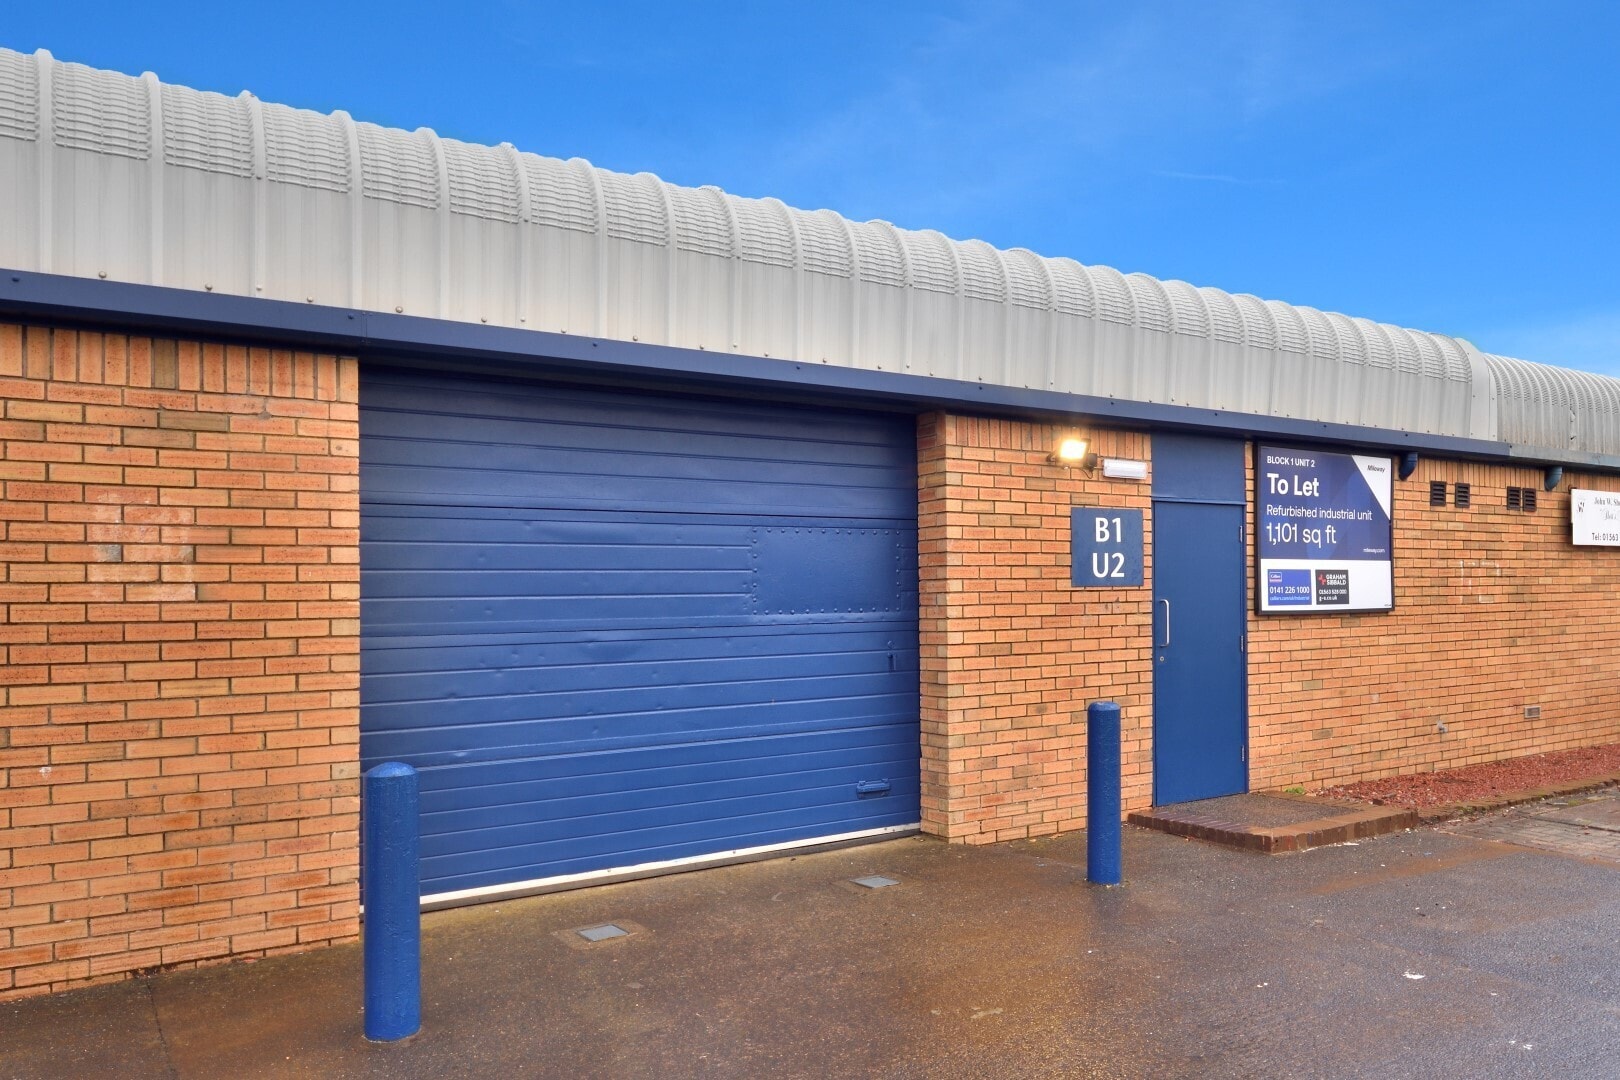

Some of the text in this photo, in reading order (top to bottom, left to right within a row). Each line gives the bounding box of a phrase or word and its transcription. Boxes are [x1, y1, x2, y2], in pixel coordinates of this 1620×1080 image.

[1266, 456, 1290, 466] BLOCK
[1295, 458, 1310, 466] UNIT
[1310, 460, 1316, 468] 2
[1266, 473, 1320, 496] To Let
[1266, 504, 1372, 520] Refurbished industrial unit
[1095, 517, 1122, 542] B1
[1266, 522, 1336, 548] 1,101 sq ft
[1592, 532, 1602, 541] Tel:
[1092, 552, 1124, 578] U2
